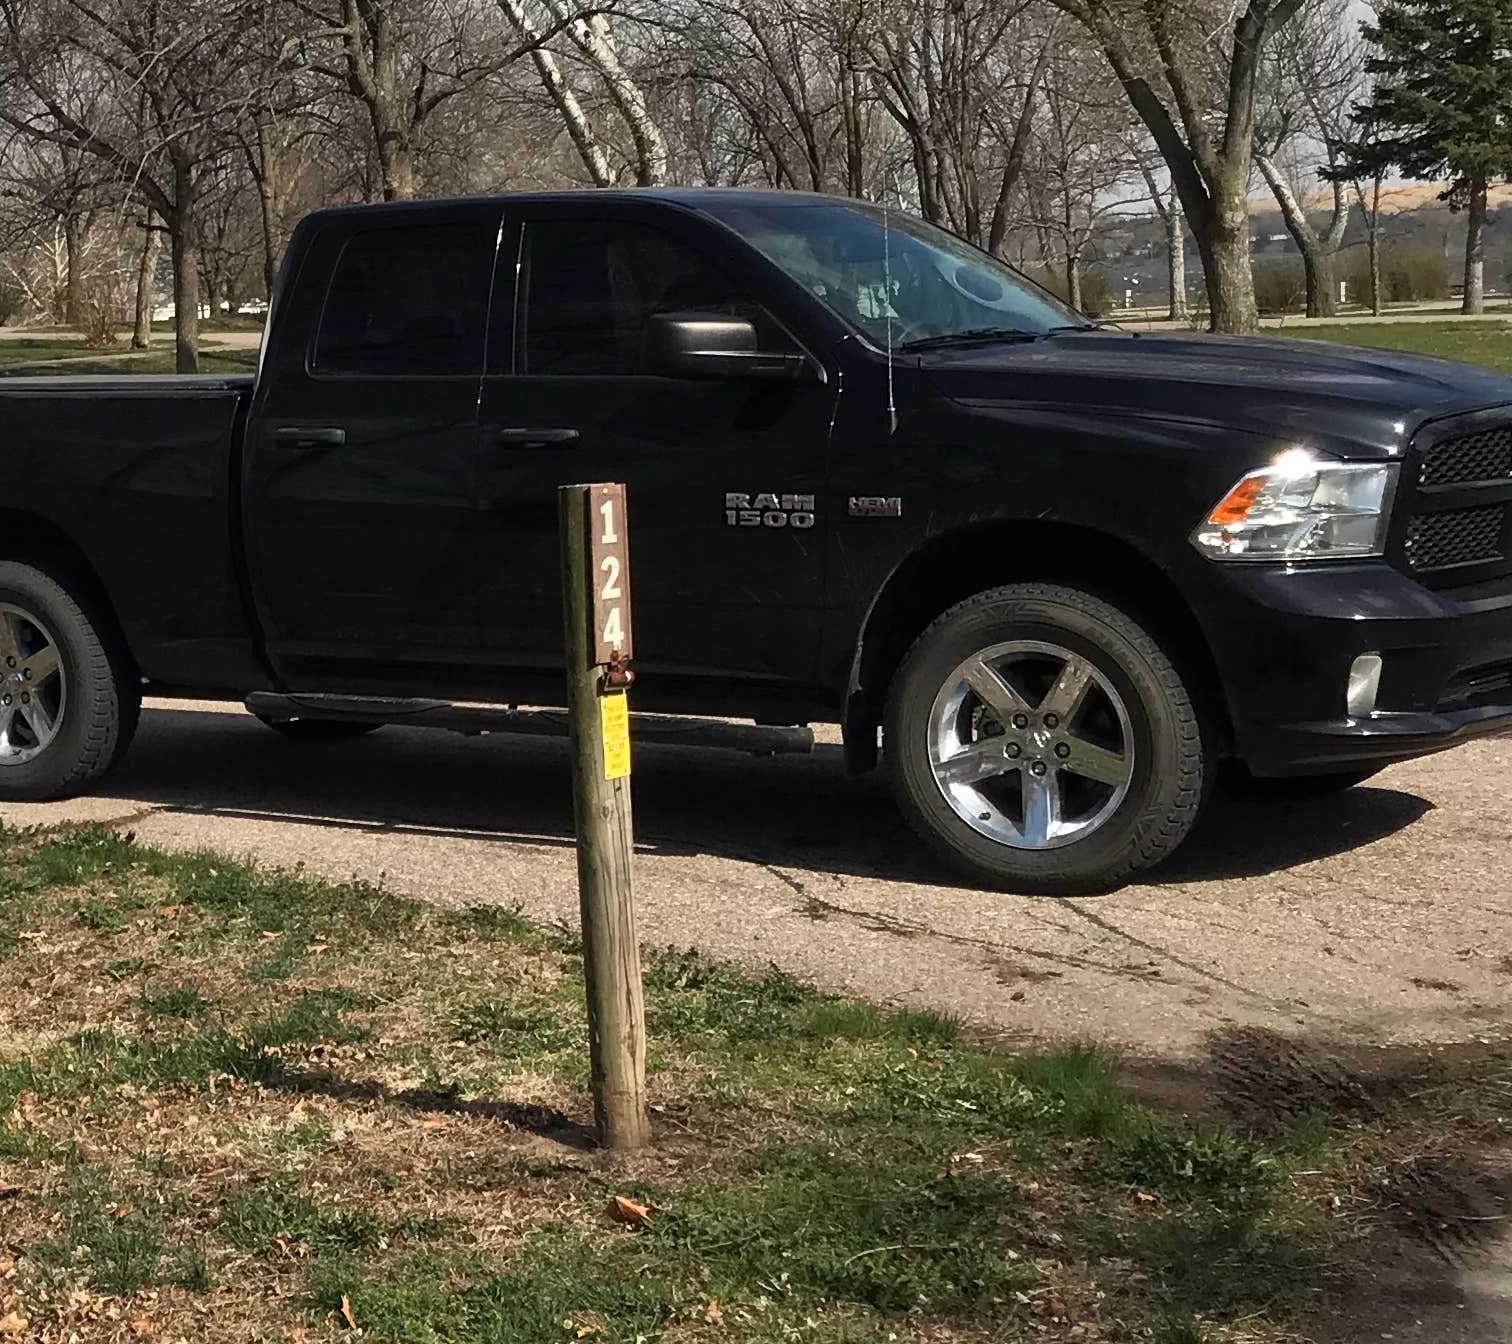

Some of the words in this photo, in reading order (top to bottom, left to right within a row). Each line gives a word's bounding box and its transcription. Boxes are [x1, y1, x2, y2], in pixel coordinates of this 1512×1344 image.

[726, 493, 815, 510] RAM
[726, 510, 815, 528] 1500
[600, 500, 625, 651] 124
